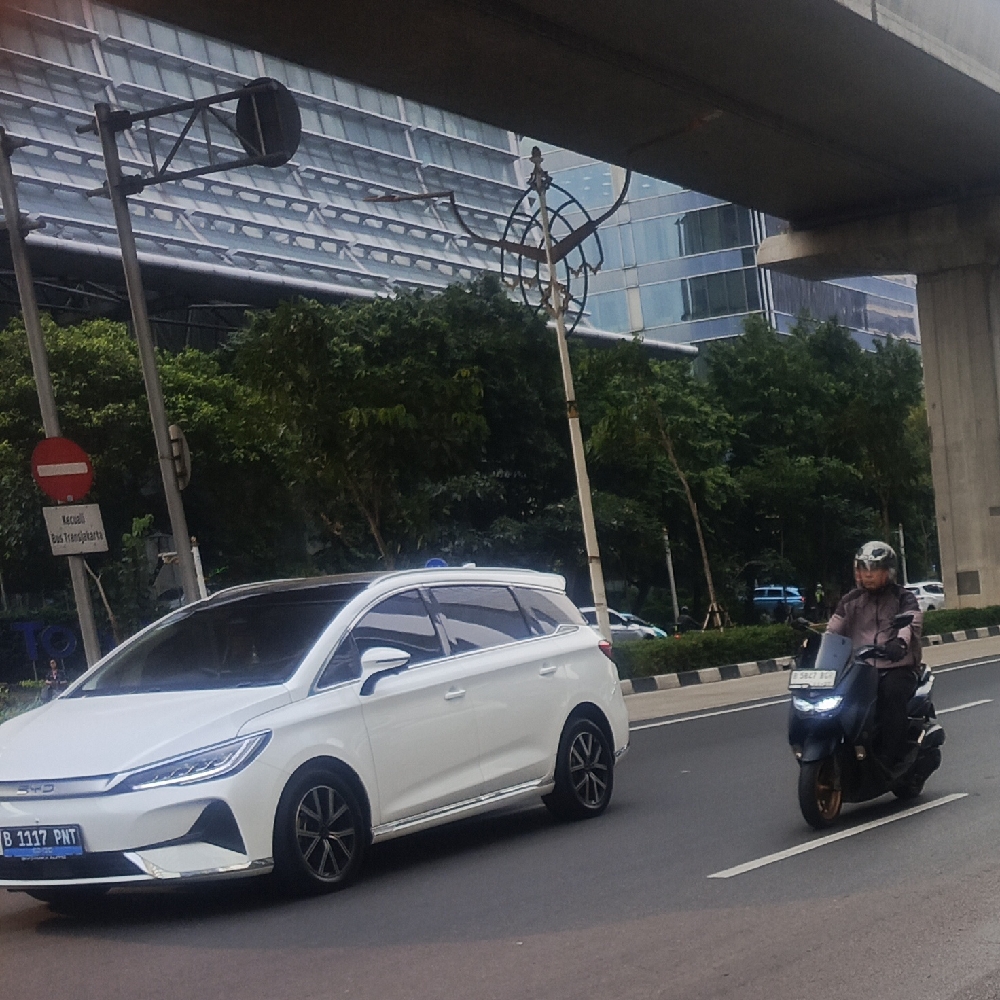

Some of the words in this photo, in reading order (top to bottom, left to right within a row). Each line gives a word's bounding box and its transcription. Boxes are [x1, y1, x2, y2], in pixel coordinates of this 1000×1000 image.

[17, 783, 55, 795] BYD
[3, 831, 13, 847] B
[17, 829, 47, 847] 1117
[53, 828, 76, 845] PNT
